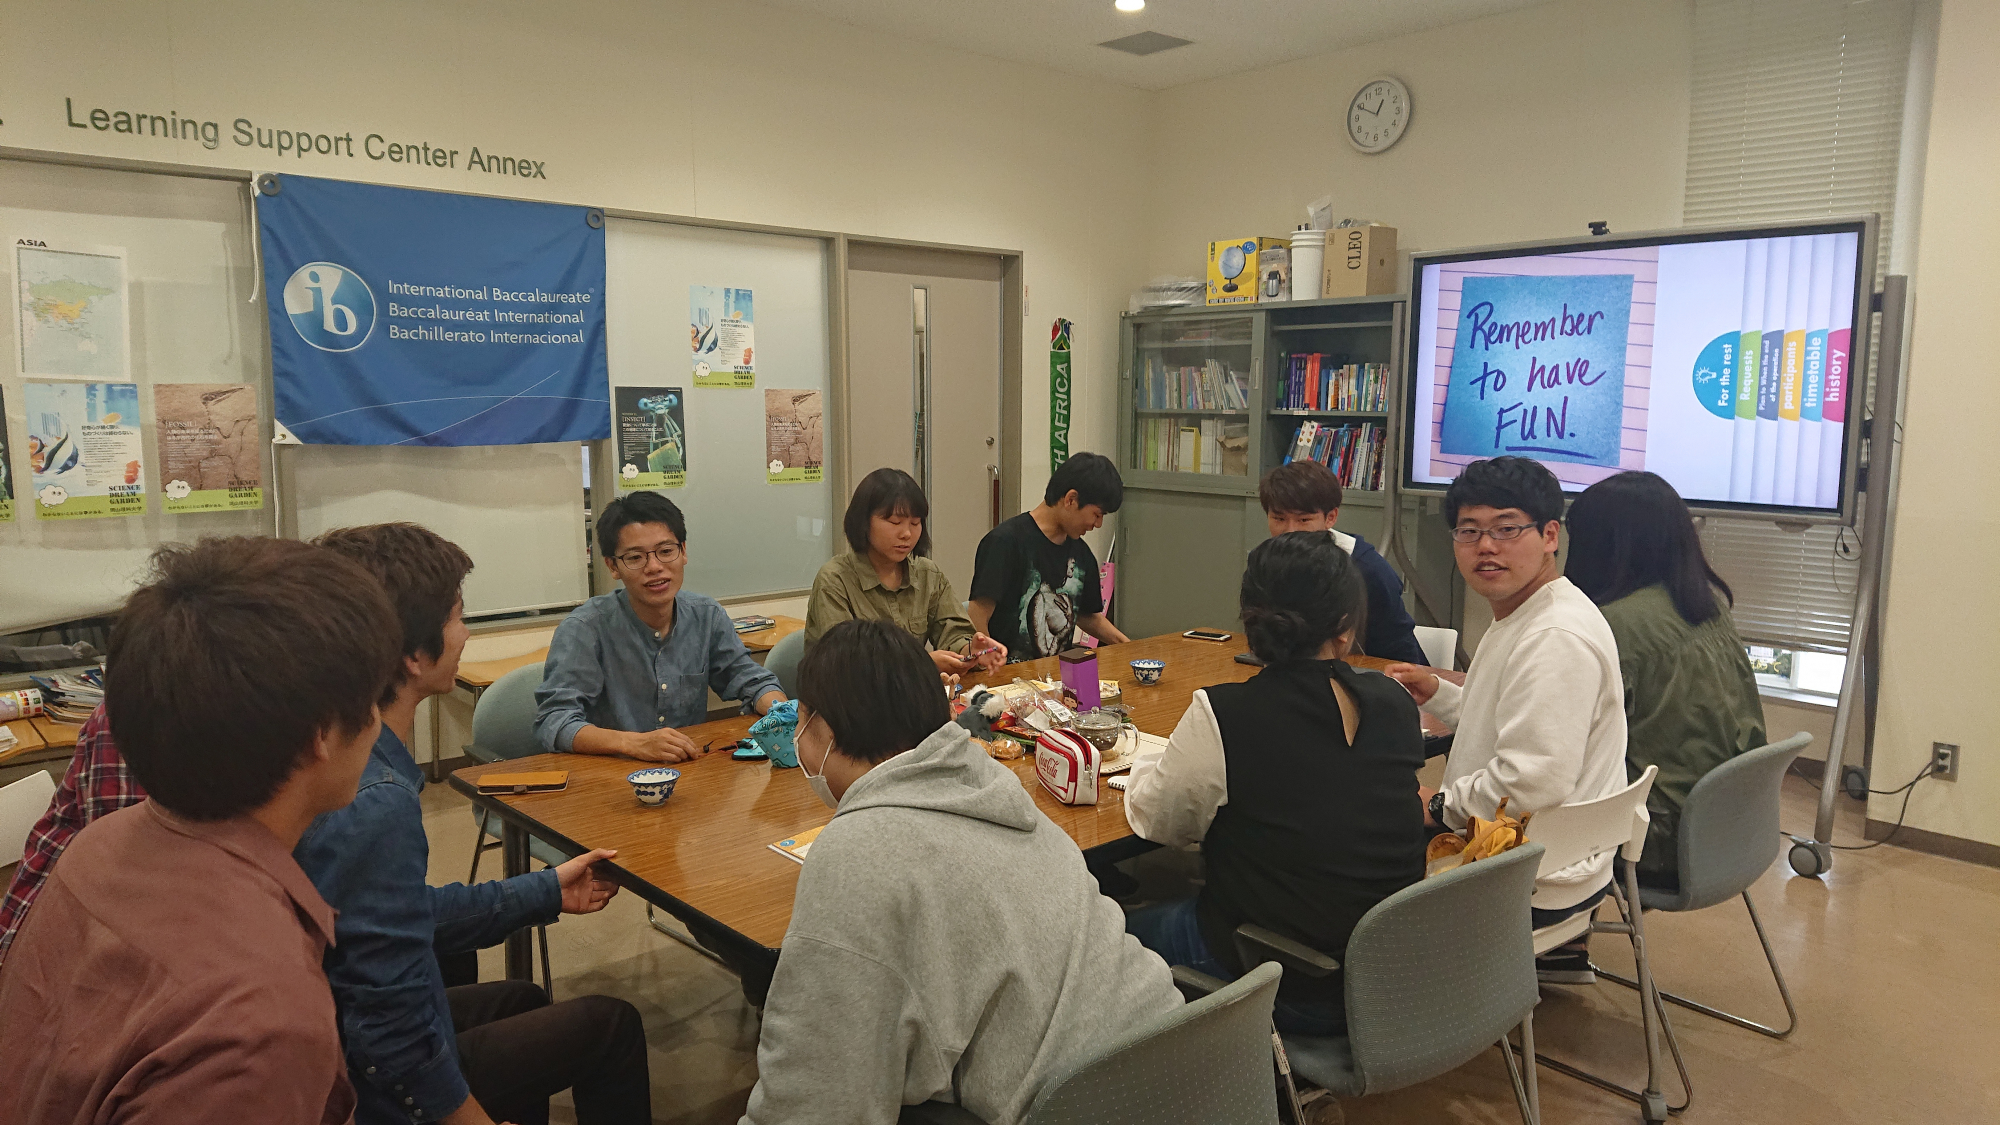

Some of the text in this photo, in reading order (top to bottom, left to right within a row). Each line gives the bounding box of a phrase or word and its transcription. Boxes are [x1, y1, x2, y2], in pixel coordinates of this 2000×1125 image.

[1365, 92, 1372, 101] 11
[1374, 87, 1383, 96] 12
[66, 97, 547, 180] Learning Support Center Annex
[16, 238, 48, 248] ASIA
[1347, 230, 1363, 270] CLEO
[304, 270, 357, 336] ib
[388, 279, 592, 304] International Baccalaureate
[388, 302, 585, 324] Baccalauréat International
[1466, 301, 1605, 351] Remember
[389, 324, 585, 345] Bachillerato Internacional
[1469, 356, 1607, 401] to have
[1718, 343, 1733, 407] For the rest
[1740, 349, 1754, 400] Requests
[1760, 366, 1768, 386] When
[1761, 354, 1769, 366] the
[1769, 348, 1780, 402] of the operation
[1783, 340, 1798, 410] participants
[1803, 336, 1822, 407] timetable
[1825, 349, 1846, 402] history
[1054, 362, 1069, 445] AFRICA
[1758, 394, 1766, 411] Plan
[1760, 386, 1767, 394] to
[1494, 395, 1576, 449] FUN.
[108, 484, 141, 492] SCIENCE
[109, 497, 141, 505] GARDEN
